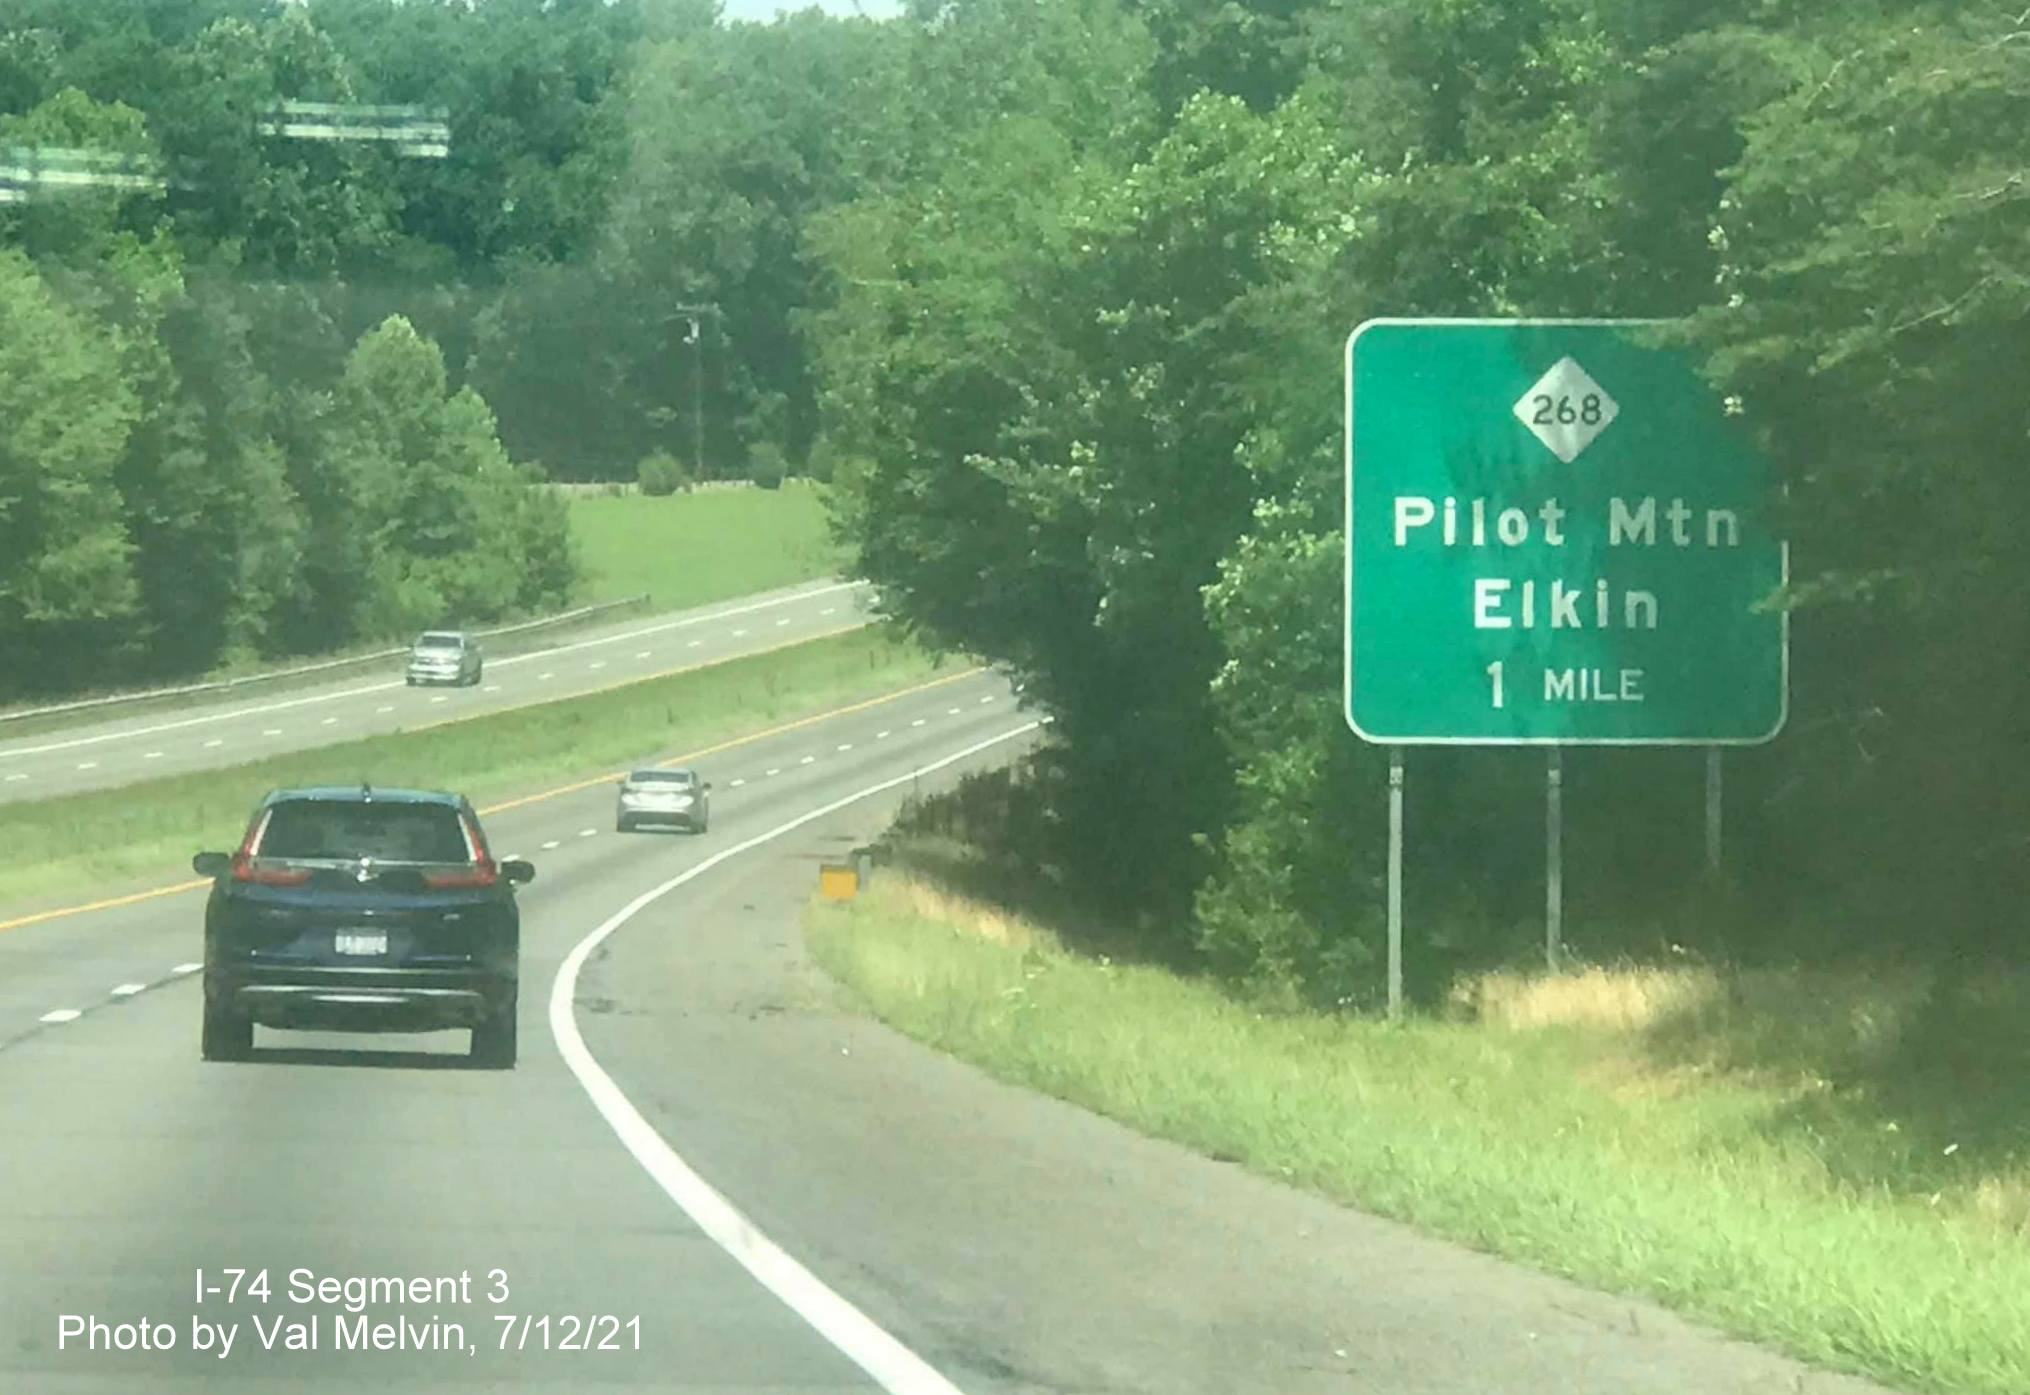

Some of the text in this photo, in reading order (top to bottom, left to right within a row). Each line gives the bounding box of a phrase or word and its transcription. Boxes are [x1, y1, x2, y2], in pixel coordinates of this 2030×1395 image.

[1533, 395, 1602, 426] 268
[1393, 496, 1740, 547] Pilot Mtn
[1473, 578, 1659, 629] Elkin
[1487, 661, 1645, 709] 1 MILE
